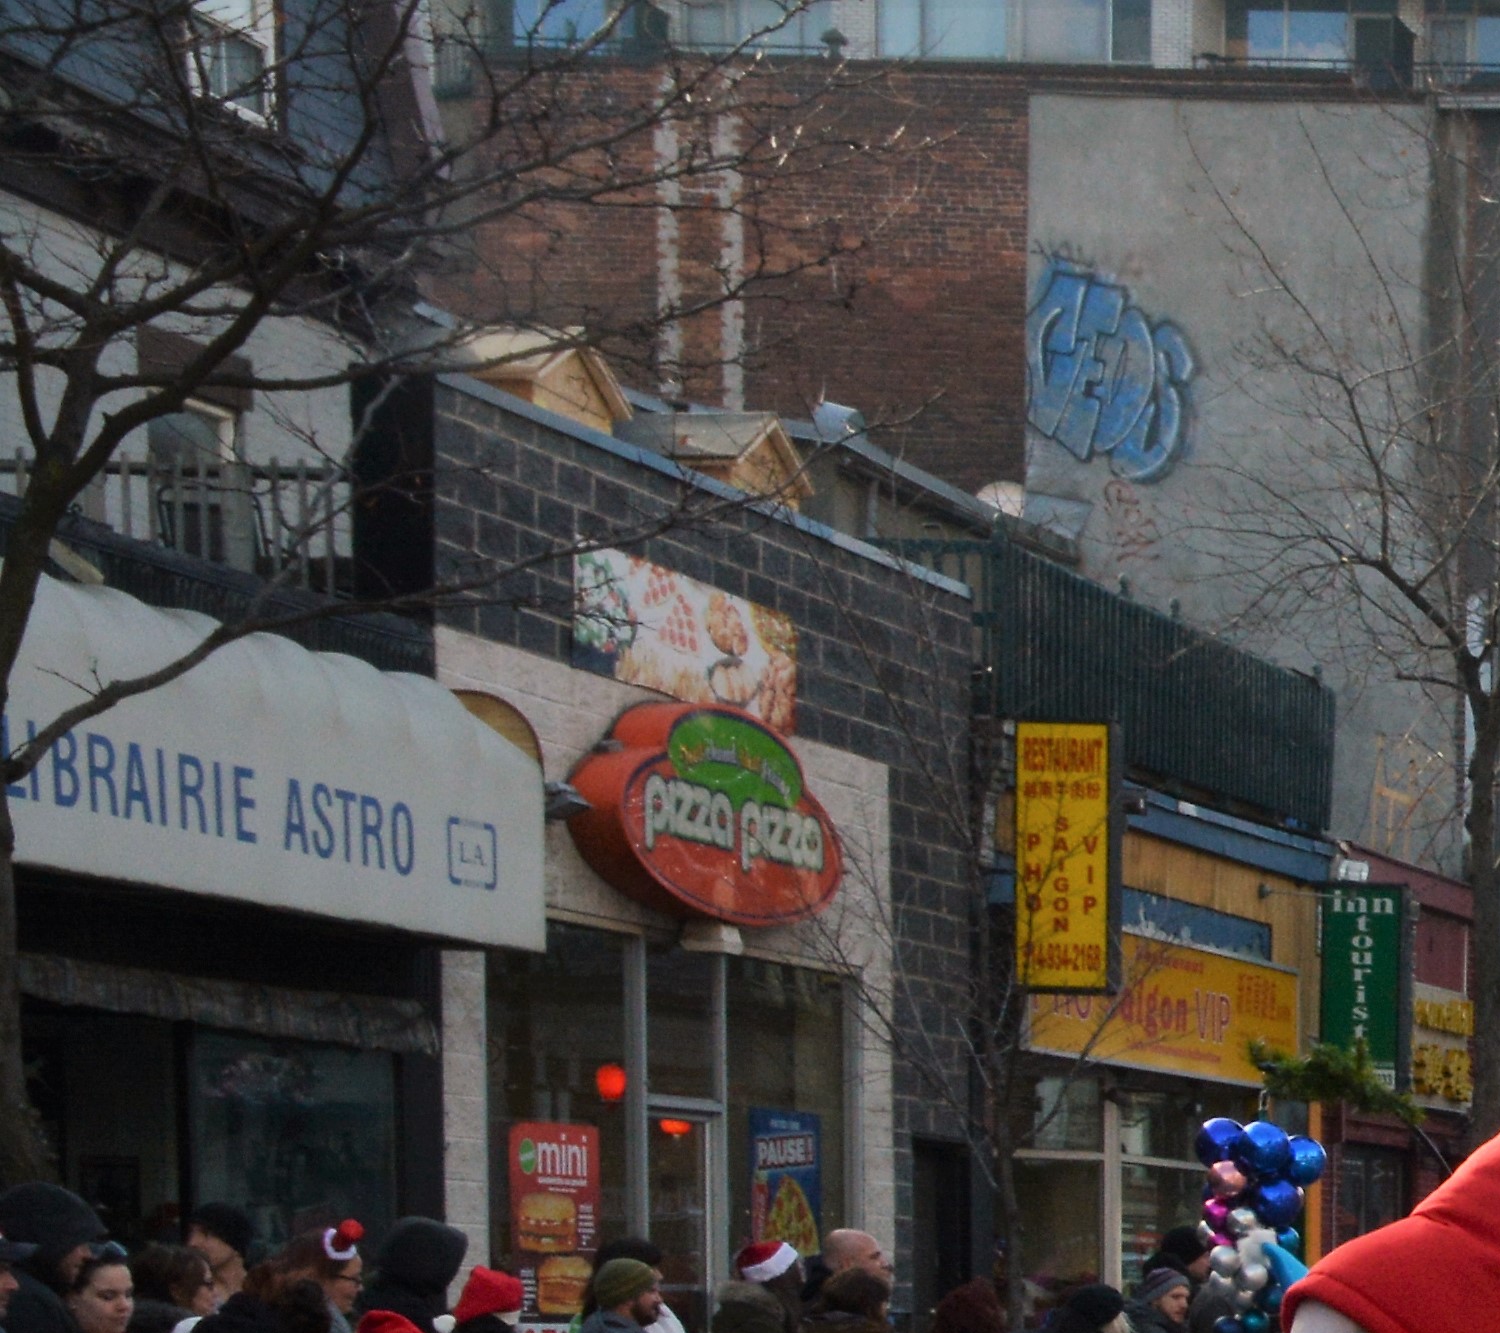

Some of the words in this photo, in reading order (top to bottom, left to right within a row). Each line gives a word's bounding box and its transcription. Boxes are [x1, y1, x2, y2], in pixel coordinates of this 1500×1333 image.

[284, 778, 414, 877] ASTRO
[1052, 815, 1070, 934] SAIGON
[1083, 836, 1098, 916] VIP
[537, 1133, 589, 1177] mini
